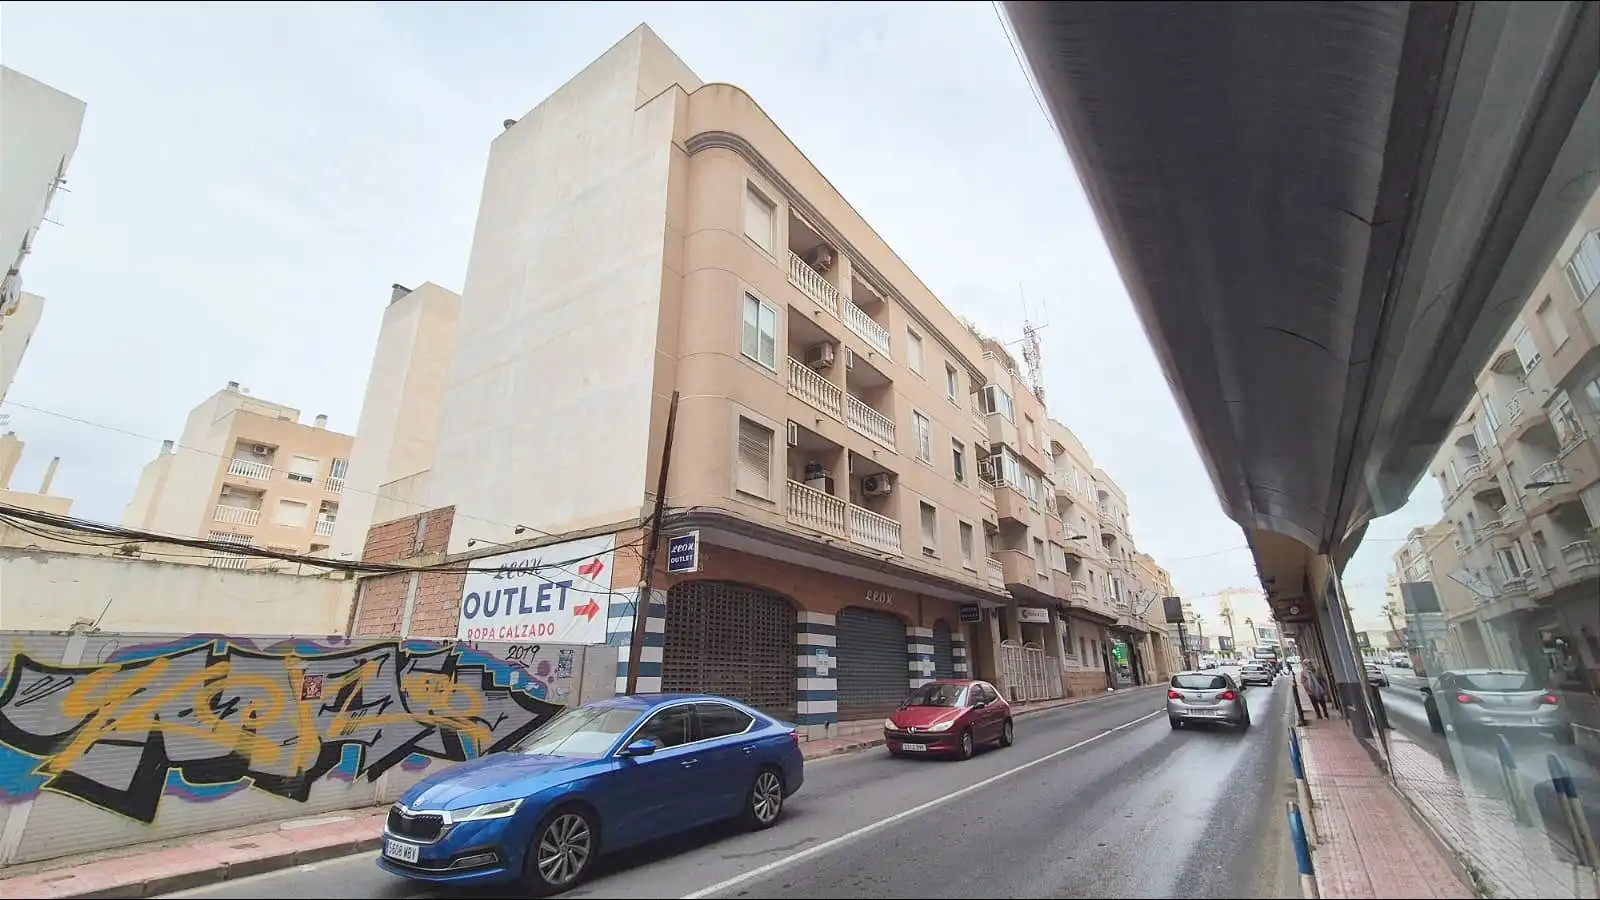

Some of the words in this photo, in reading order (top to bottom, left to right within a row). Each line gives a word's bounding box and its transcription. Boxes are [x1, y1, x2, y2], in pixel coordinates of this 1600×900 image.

[671, 555, 693, 564] OUTLET
[463, 580, 573, 619] OUTLET
[467, 627, 496, 641] ROPA
[499, 622, 555, 639] CALZADO
[505, 644, 541, 665] 2019
